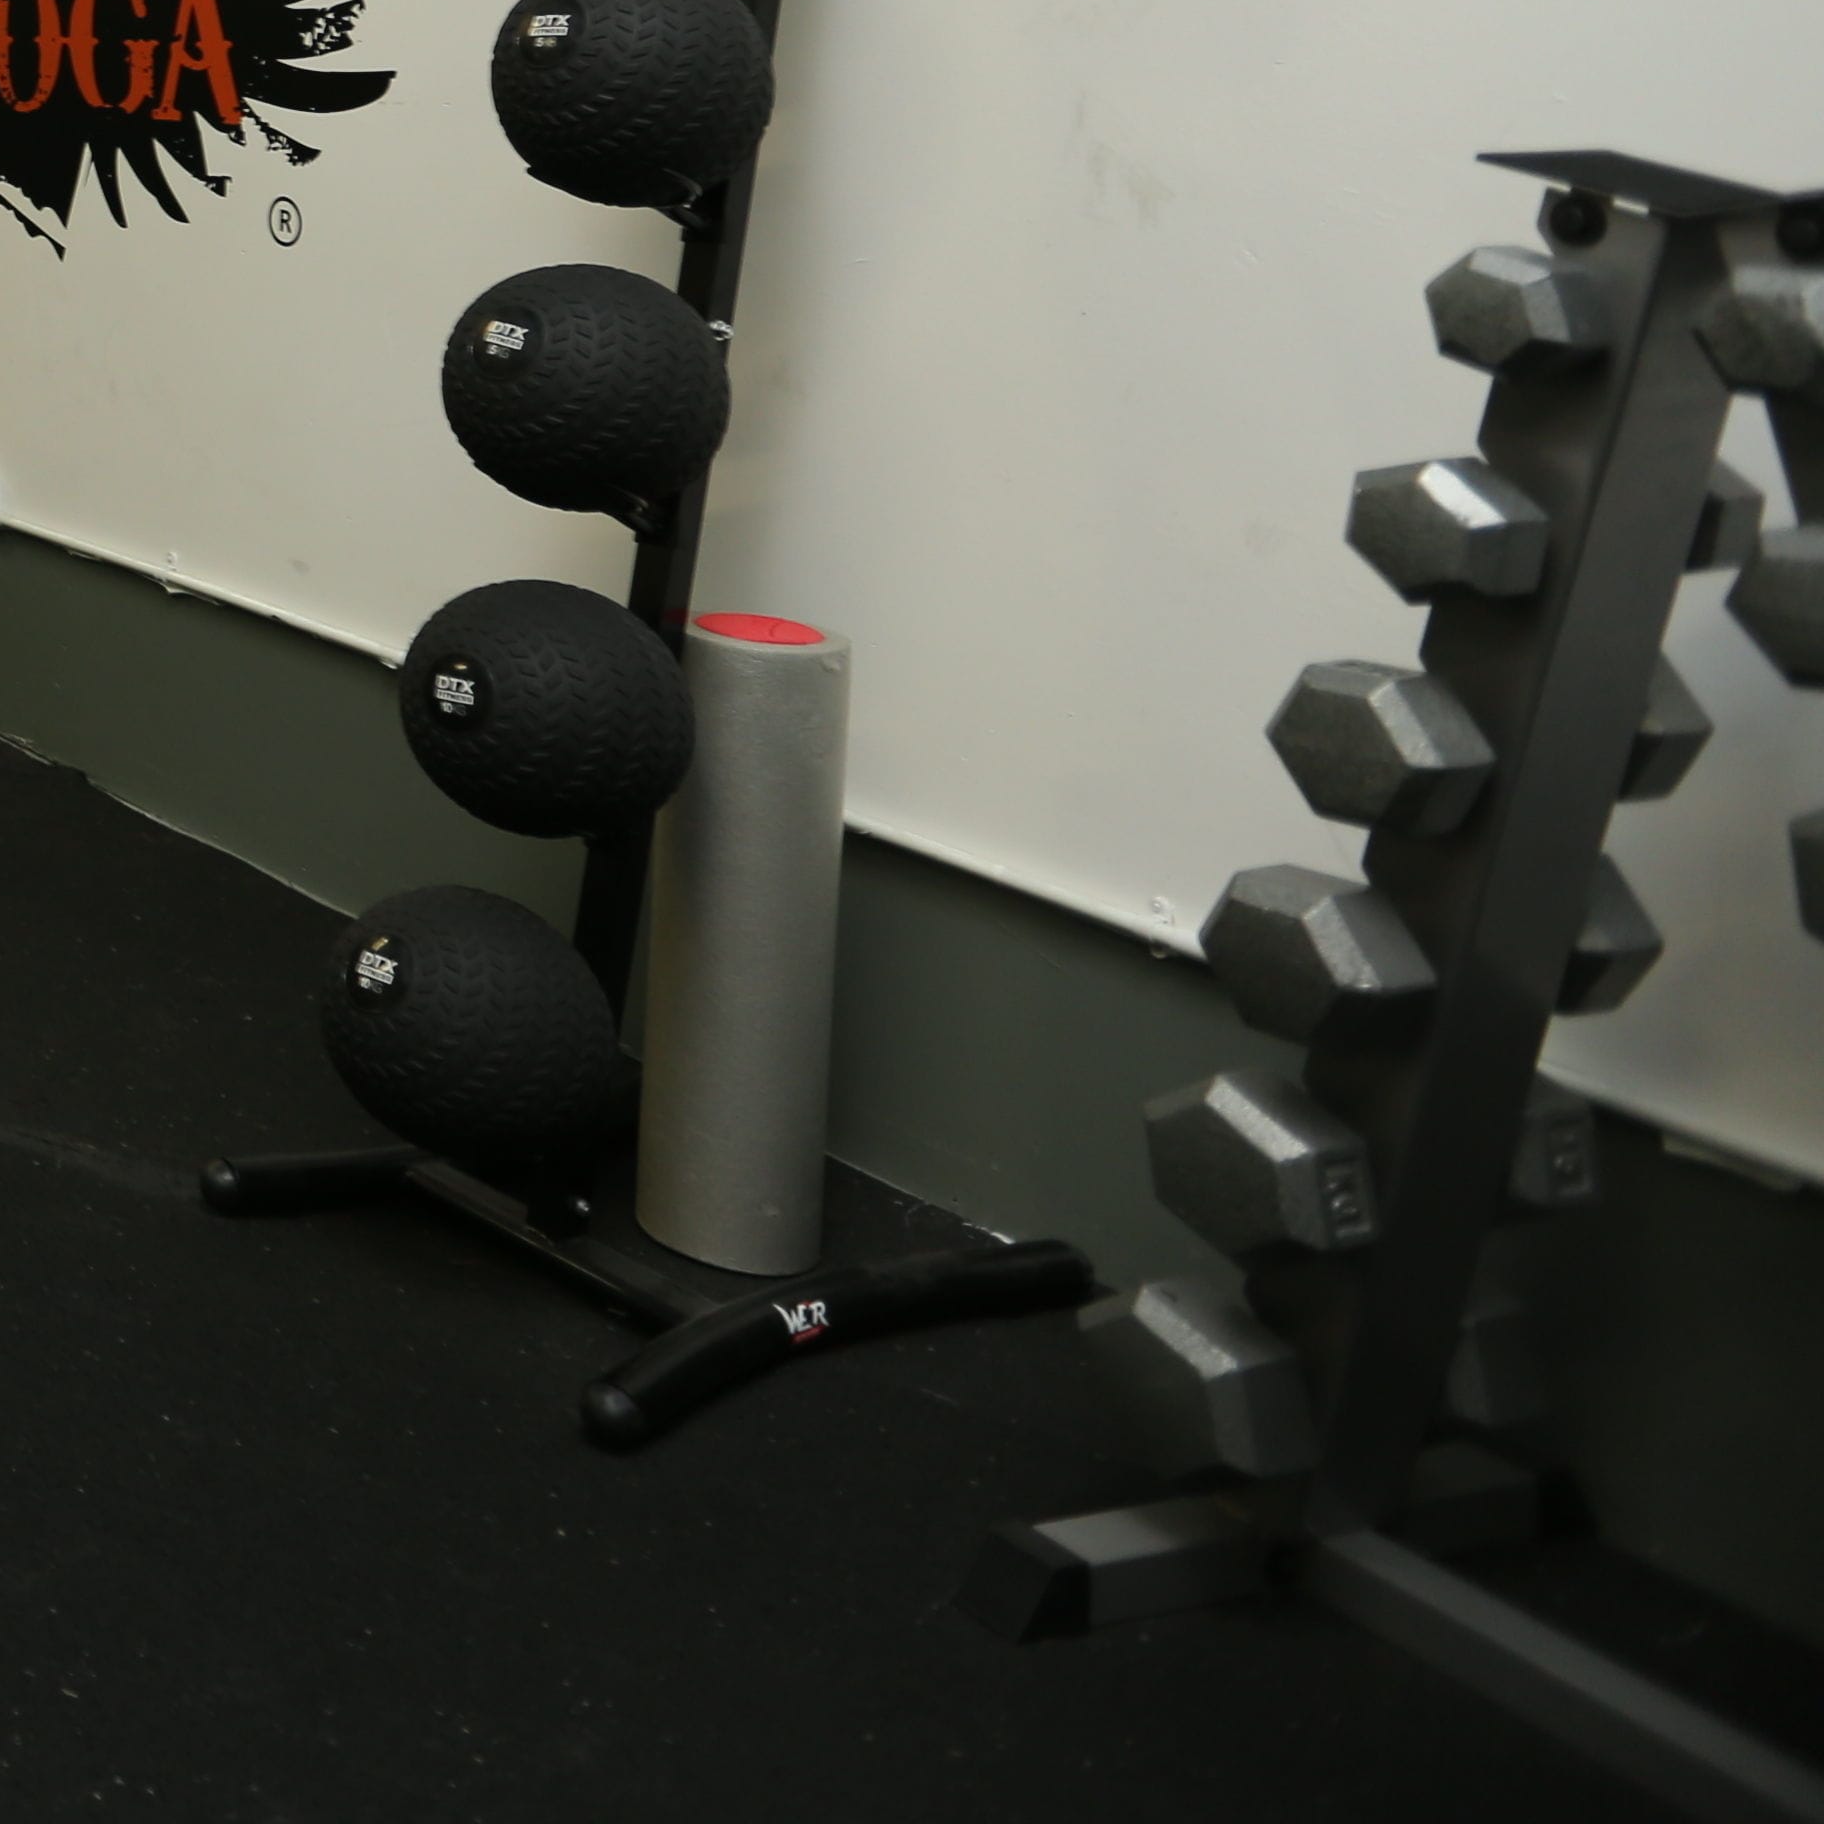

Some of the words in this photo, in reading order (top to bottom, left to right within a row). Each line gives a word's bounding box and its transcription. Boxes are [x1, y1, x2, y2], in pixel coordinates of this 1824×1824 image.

[531, 14, 572, 27] DTX
[486, 320, 529, 341] DTX
[435, 675, 475, 694] DTX
[359, 950, 399, 975] DTX
